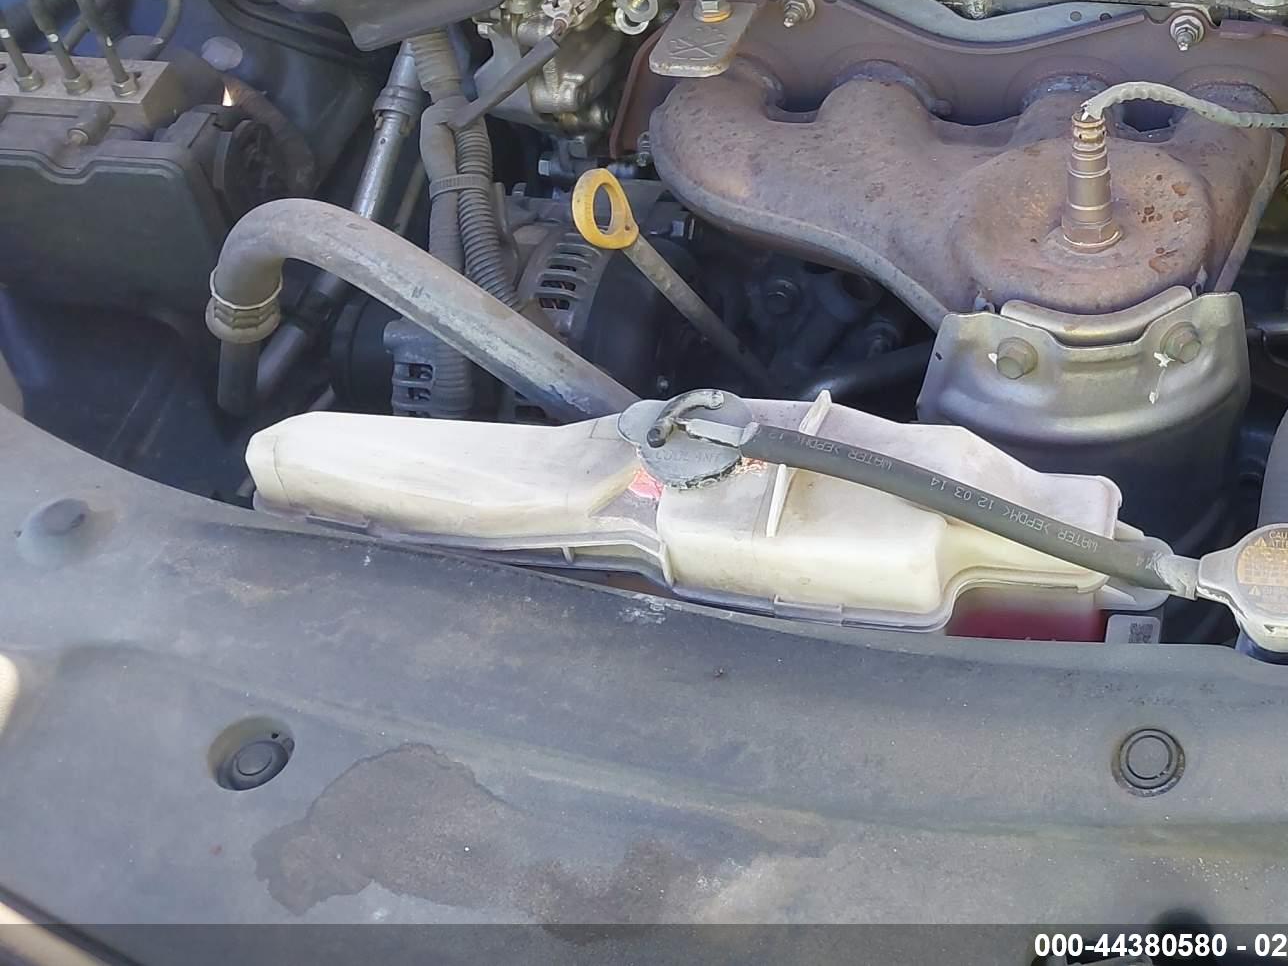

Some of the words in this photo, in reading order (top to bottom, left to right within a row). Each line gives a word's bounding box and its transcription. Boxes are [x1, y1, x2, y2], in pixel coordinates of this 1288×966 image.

[847, 449, 894, 471] WATER
[930, 477, 948, 492] 14
[953, 486, 972, 501] 03
[977, 496, 994, 511] 12
[1057, 528, 1098, 552] WATER
